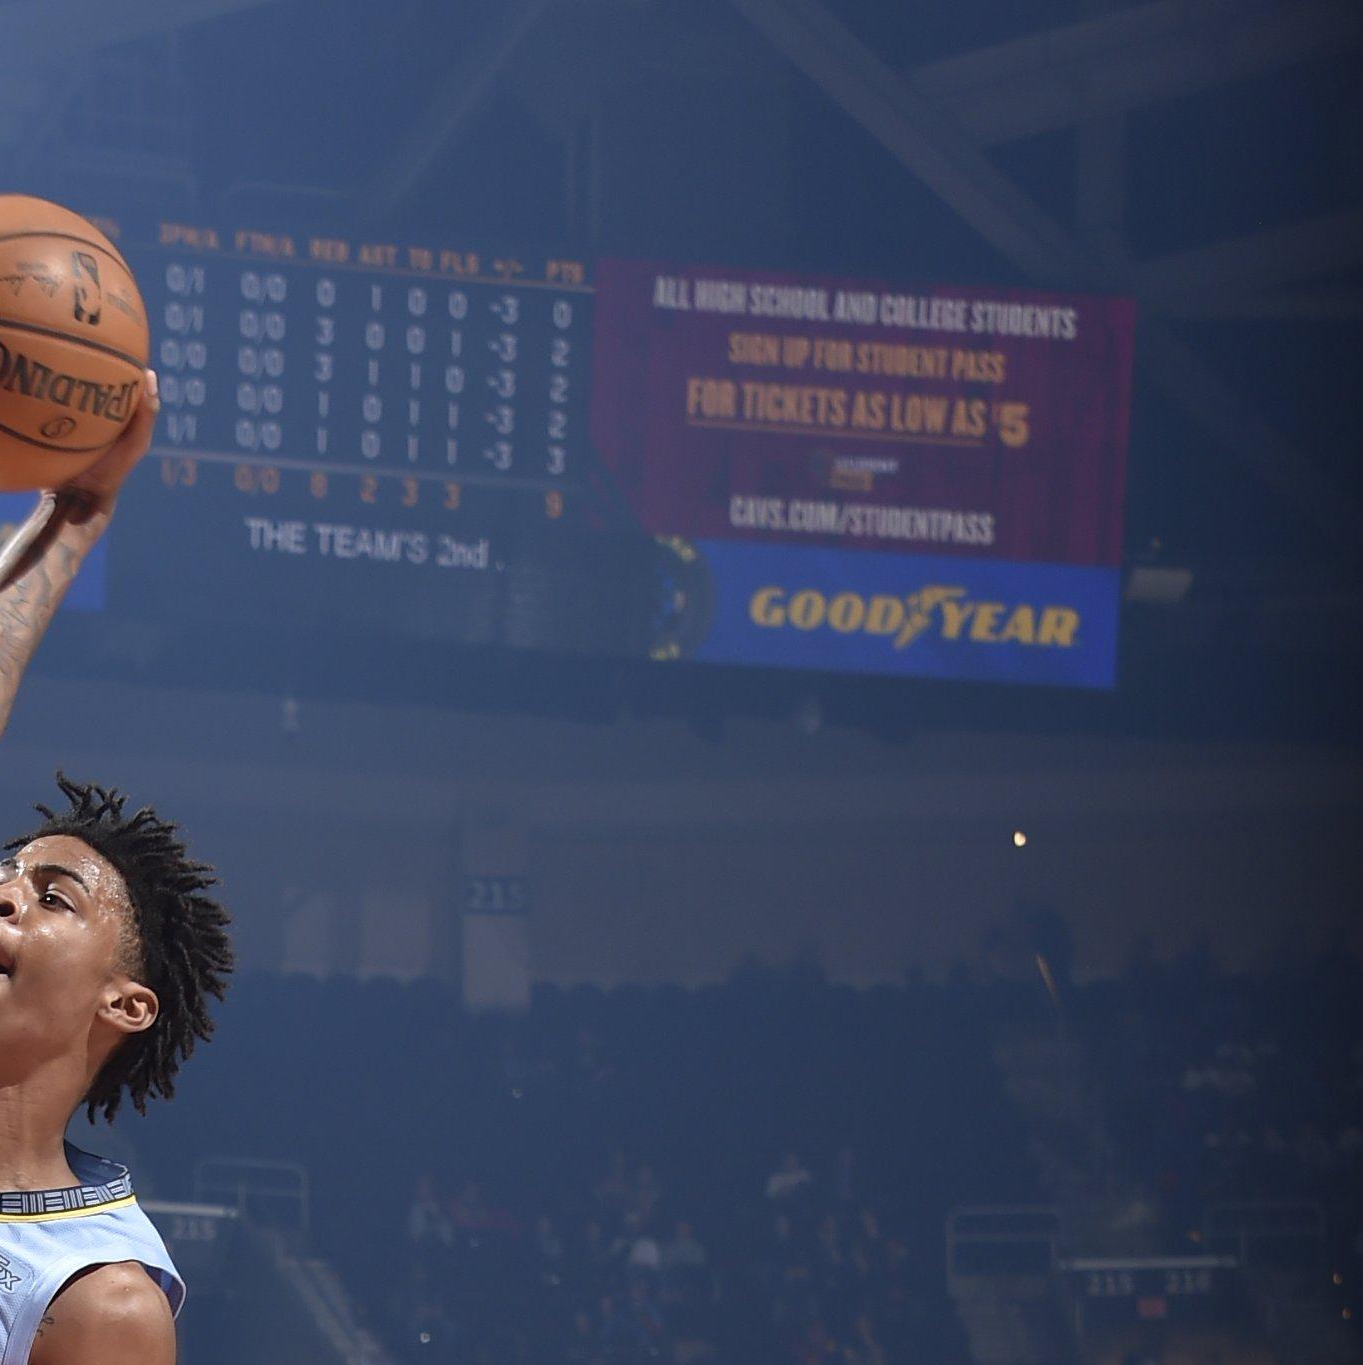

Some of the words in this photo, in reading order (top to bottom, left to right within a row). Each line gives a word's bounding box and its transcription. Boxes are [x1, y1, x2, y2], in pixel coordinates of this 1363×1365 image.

[166, 263, 205, 295] 0/1
[240, 271, 287, 304] 0/0
[316, 278, 335, 308] 0
[408, 287, 427, 317] 0
[448, 290, 468, 321] 0
[553, 300, 572, 330] 0
[653, 275, 691, 310] ALL
[694, 278, 747, 315] HIGH
[748, 283, 831, 322] SCHOOL
[833, 289, 877, 326] AND
[879, 292, 968, 332] COLLEGE
[970, 300, 1078, 340] STUDENTS
[164, 301, 204, 334] 0/1
[239, 308, 286, 342] 0/0
[316, 316, 335, 346] 3
[365, 321, 385, 350] 0
[406, 325, 426, 354] 0
[551, 338, 570, 367] 2
[729, 331, 781, 367] SIGN
[782, 335, 810, 369] UP
[813, 337, 853, 372] FOR
[856, 341, 948, 380] STUDENT
[951, 347, 1007, 385] PASS
[160, 339, 208, 372] 0/0
[237, 346, 285, 380] 0/0
[314, 352, 334, 382] 3
[445, 365, 465, 394] 0
[549, 374, 569, 403] 2
[160, 375, 207, 408] 0/0
[237, 382, 284, 416] 0/0
[363, 394, 383, 423] 0
[548, 410, 567, 439] 2
[687, 376, 736, 418] FOR
[743, 380, 848, 428] TICKETS
[852, 389, 887, 432] AS
[890, 392, 949, 434] LOW
[951, 397, 988, 437] AS
[166, 413, 197, 445] 1/1
[235, 418, 282, 452] 0/0
[361, 429, 381, 459] 0
[548, 445, 565, 475] 3
[244, 516, 308, 554] THE
[314, 522, 430, 565] TEAM'S
[437, 533, 490, 570] 2nd
[749, 584, 1081, 650] GOODYEAR
